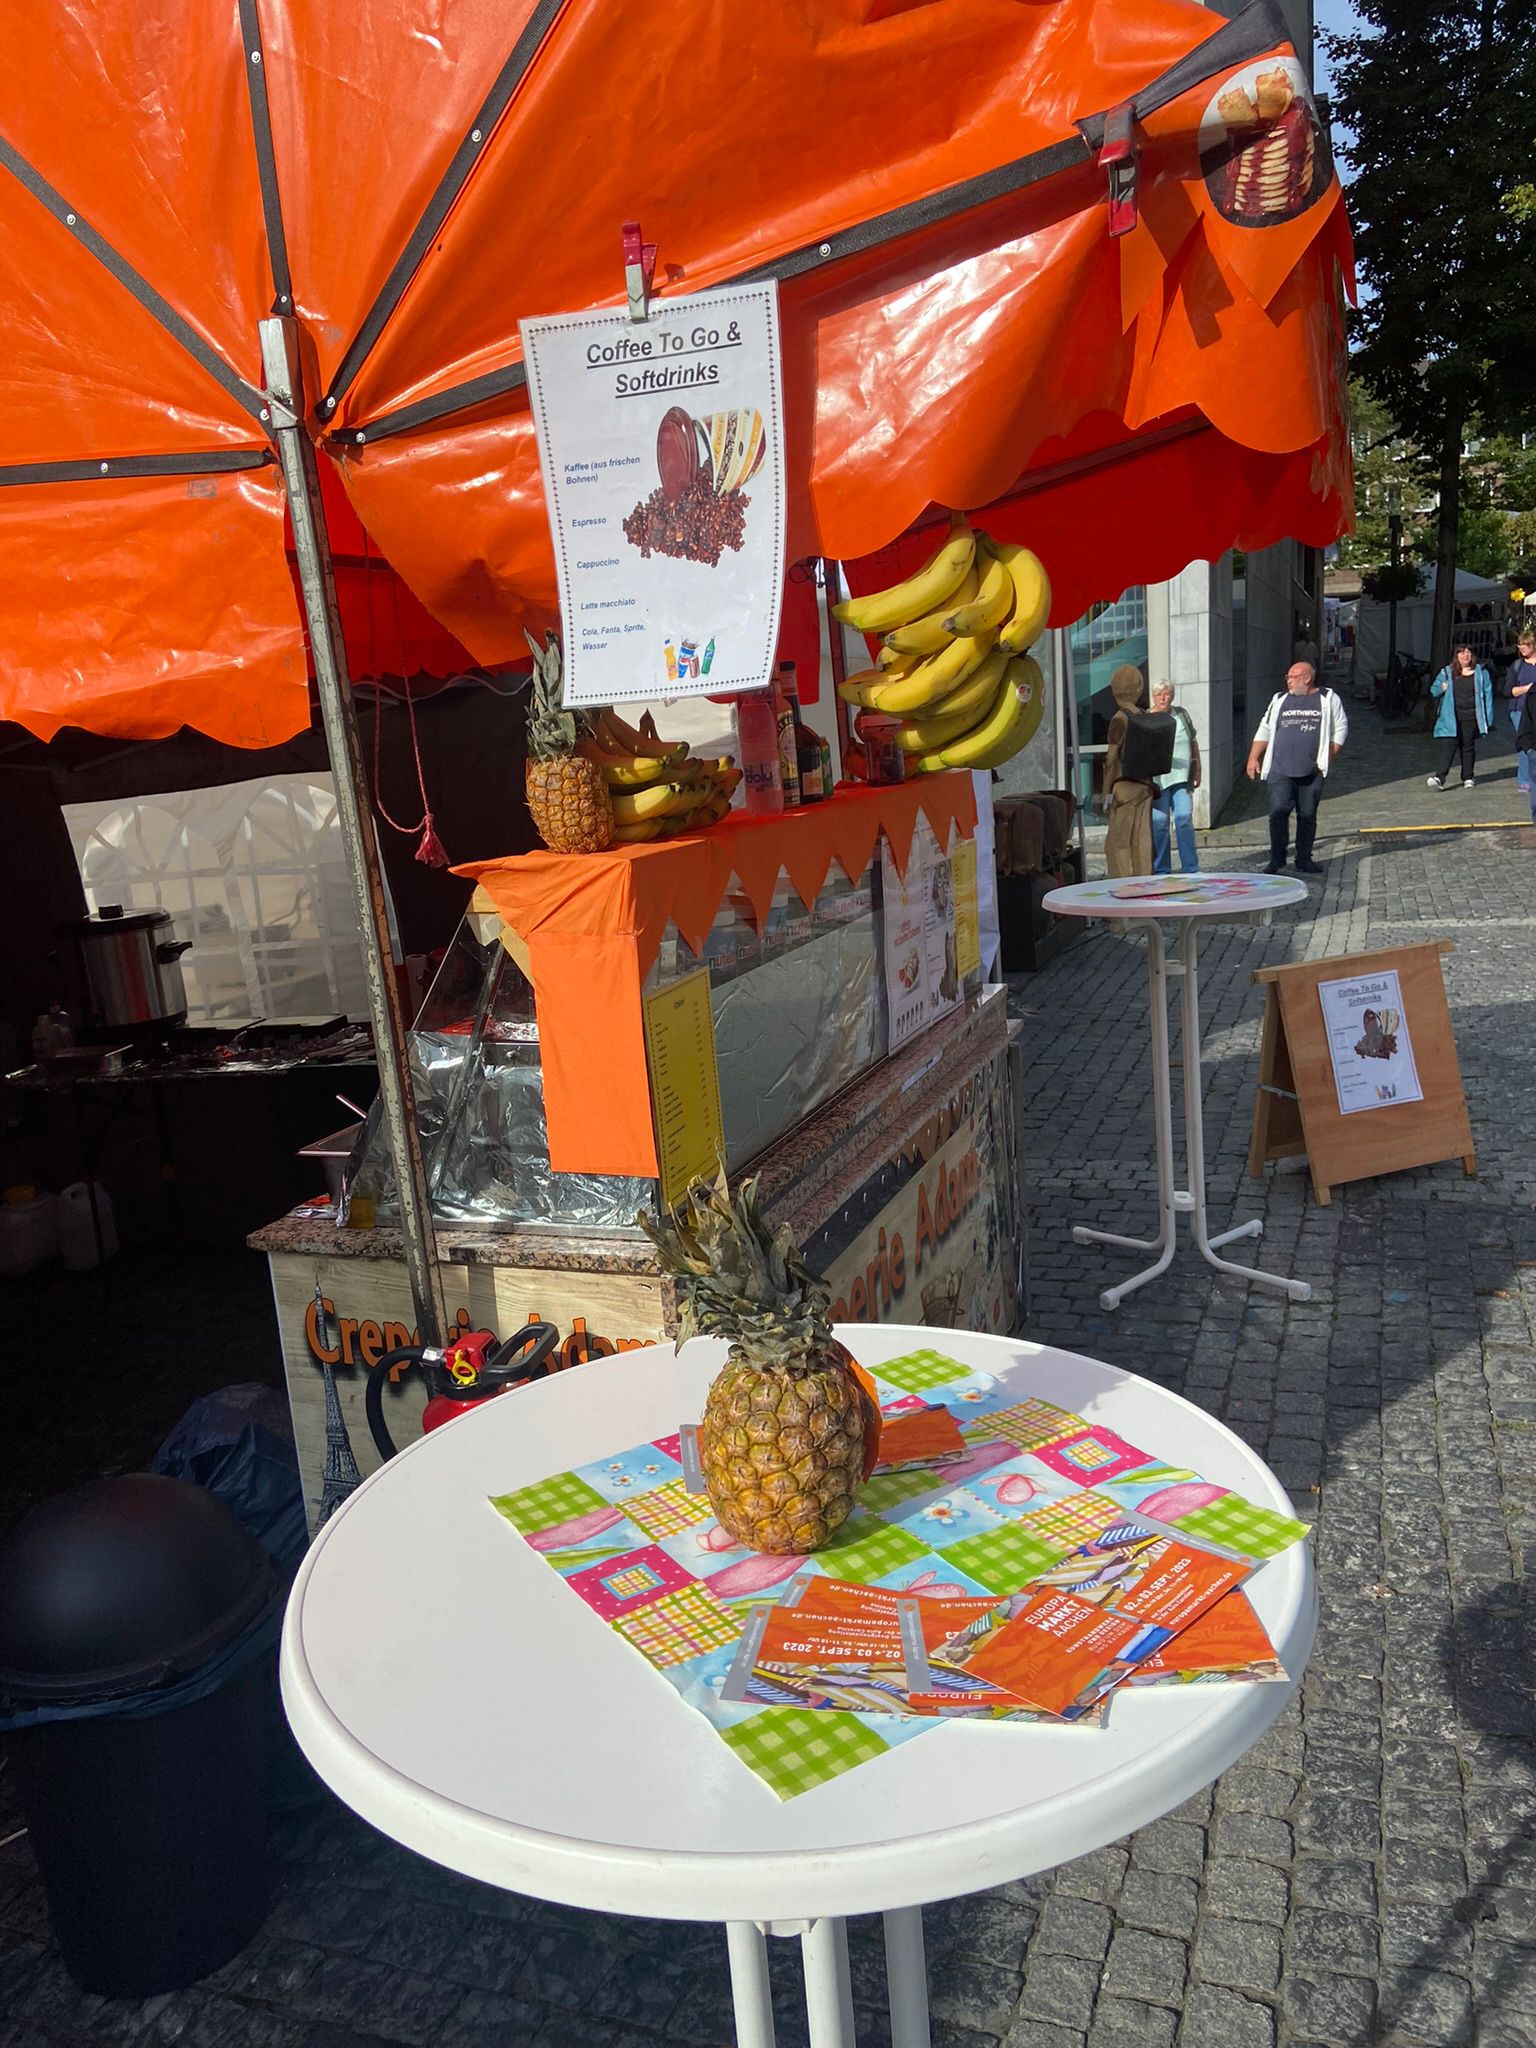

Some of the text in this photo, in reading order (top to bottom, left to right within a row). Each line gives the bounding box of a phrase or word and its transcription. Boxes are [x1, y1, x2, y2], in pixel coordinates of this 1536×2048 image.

[586, 321, 741, 364] Coffee To Go &
[616, 362, 719, 393] Softdrinks
[564, 456, 641, 473] Kaffee (aus frischen
[566, 474, 599, 485] Bohnen)
[572, 517, 607, 528] Espresso
[576, 557, 620, 569] Cappuccino
[580, 598, 636, 610] Latte macchiato
[582, 623, 646, 636] Cola, Fanta, Sprite,
[582, 642, 608, 651] Wasser
[914, 1149, 980, 1267] Adam
[1150, 1573, 1176, 1591] SEPT.
[1170, 1557, 1192, 1574] 2023
[829, 1584, 898, 1602] arkt-aachen.de
[1024, 1594, 1069, 1625] EUROPA
[1036, 1599, 1081, 1632] MARKT
[791, 1613, 899, 1626] uropamarkt-aachen.de
[1052, 1606, 1095, 1638] AACHEN
[783, 1641, 813, 1653] 2023
[817, 1645, 852, 1656] SEPT.
[919, 1693, 983, 1701] EURO
